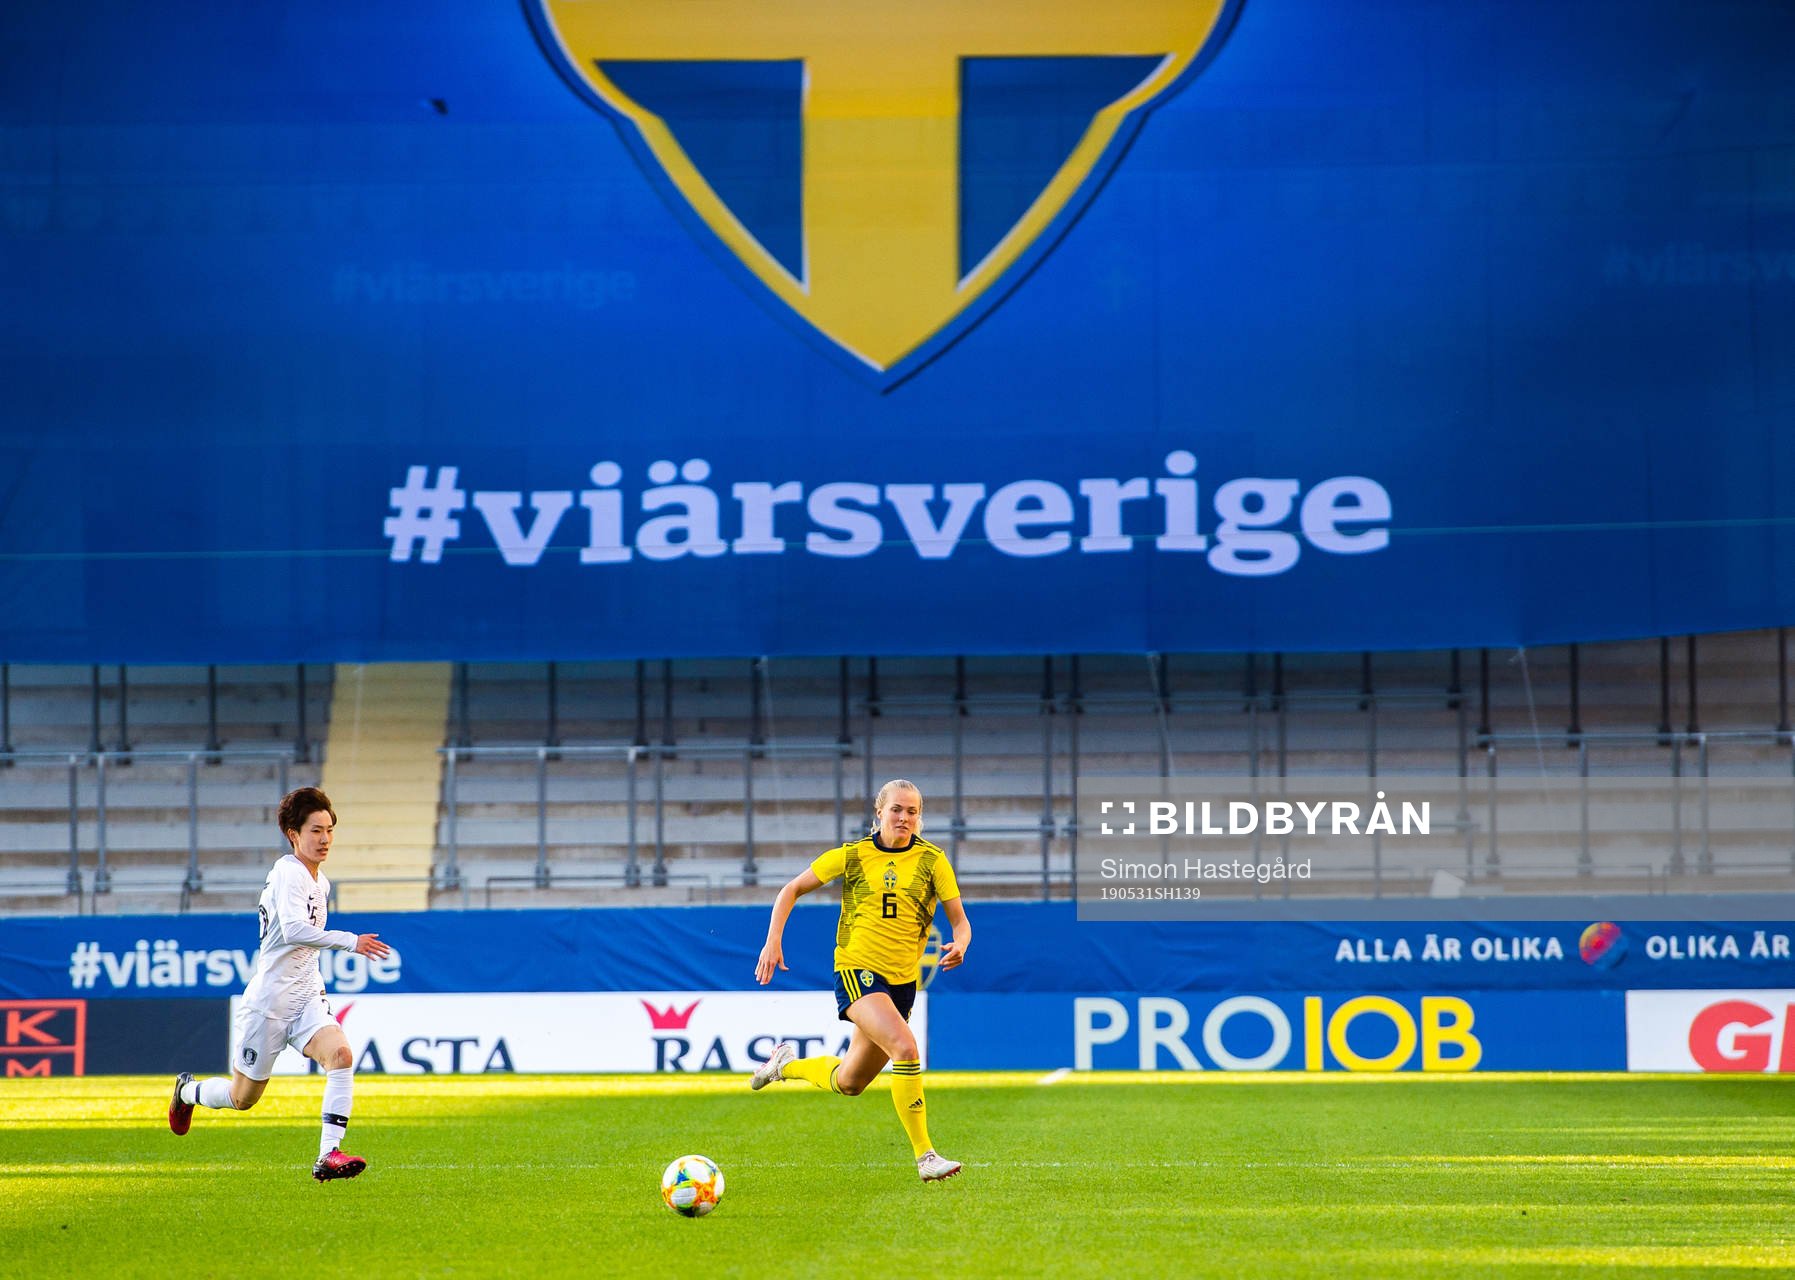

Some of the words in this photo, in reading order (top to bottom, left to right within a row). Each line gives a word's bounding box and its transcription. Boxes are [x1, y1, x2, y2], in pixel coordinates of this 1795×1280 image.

[383, 450, 1393, 577] #viärsverige
[882, 893, 897, 918] 6
[1335, 938, 1412, 961] ALLA
[1421, 933, 1461, 960] ÄR
[1471, 937, 1563, 960] OLIKA
[1645, 935, 1739, 959] OLIKA
[1749, 931, 1790, 958] ÄR
[309, 1036, 515, 1073] ASTA
